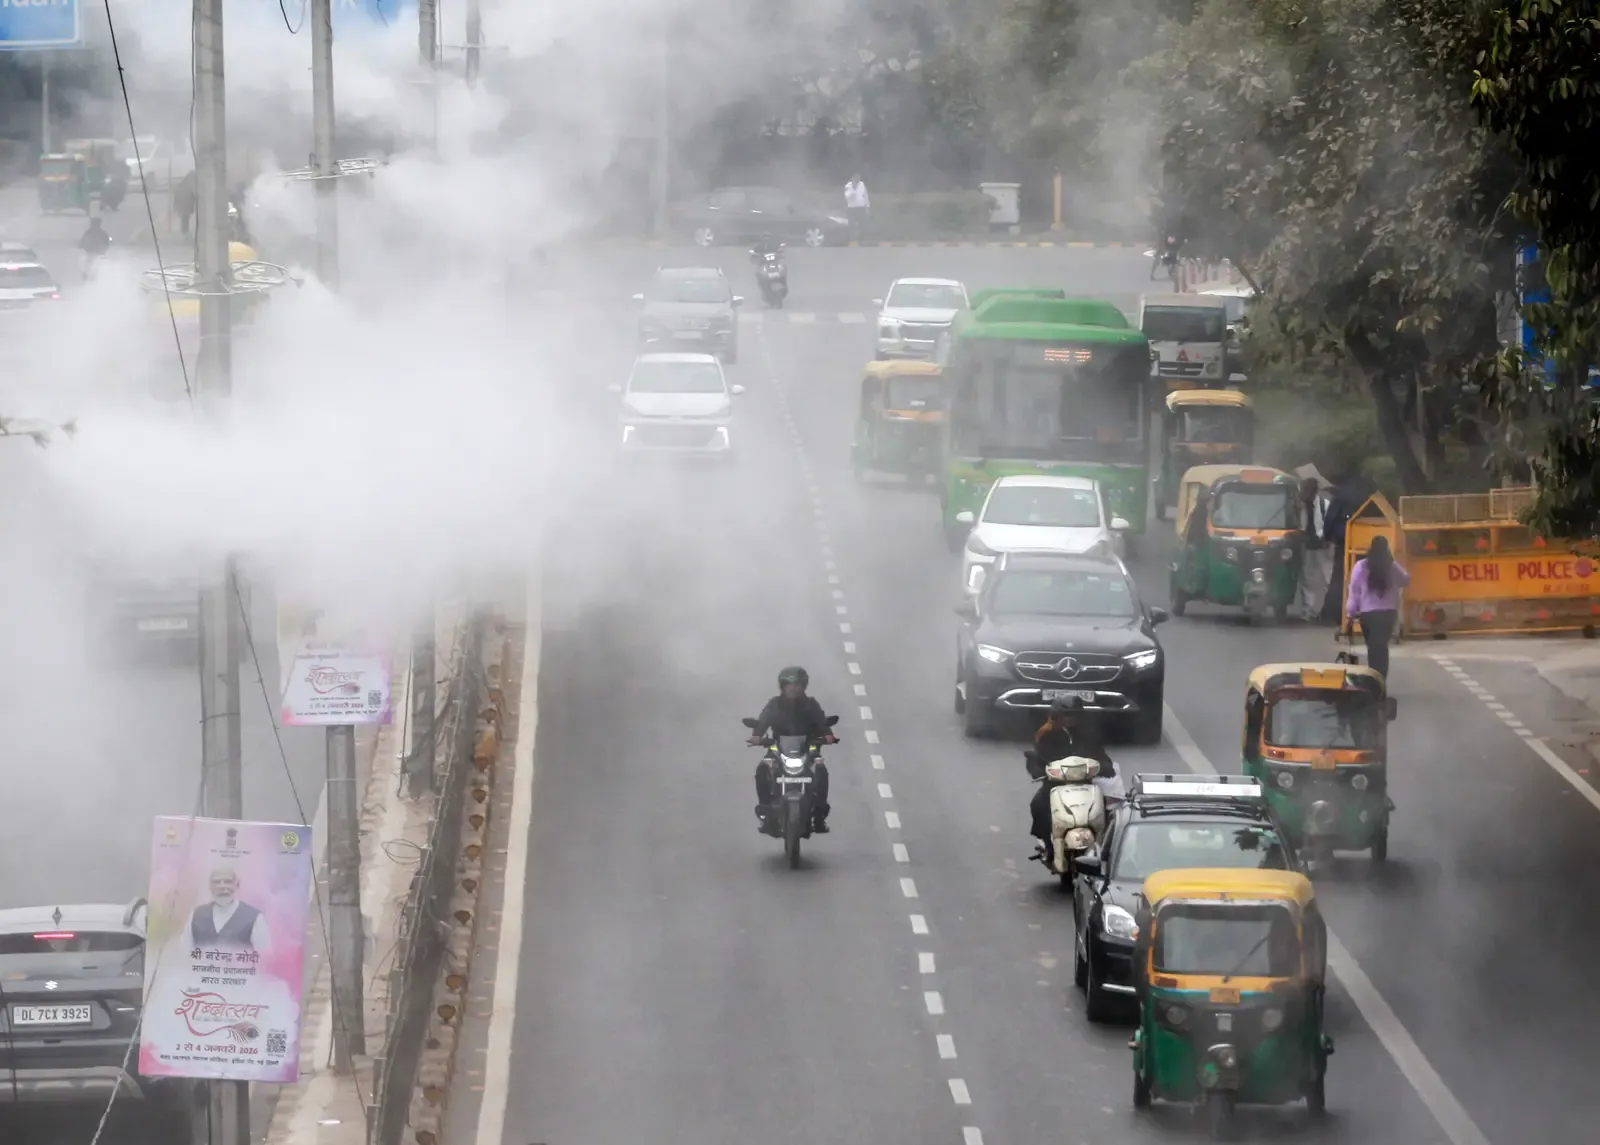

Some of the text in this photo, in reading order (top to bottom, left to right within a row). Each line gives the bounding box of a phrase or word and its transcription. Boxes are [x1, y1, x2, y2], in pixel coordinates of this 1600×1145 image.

[1448, 561, 1573, 581] DELHI POLICE
[191, 947, 202, 960] श्री
[236, 950, 260, 963] मोदी
[21, 1007, 89, 1021] DL 7CX 3925
[204, 1043, 236, 1054] जनवरी
